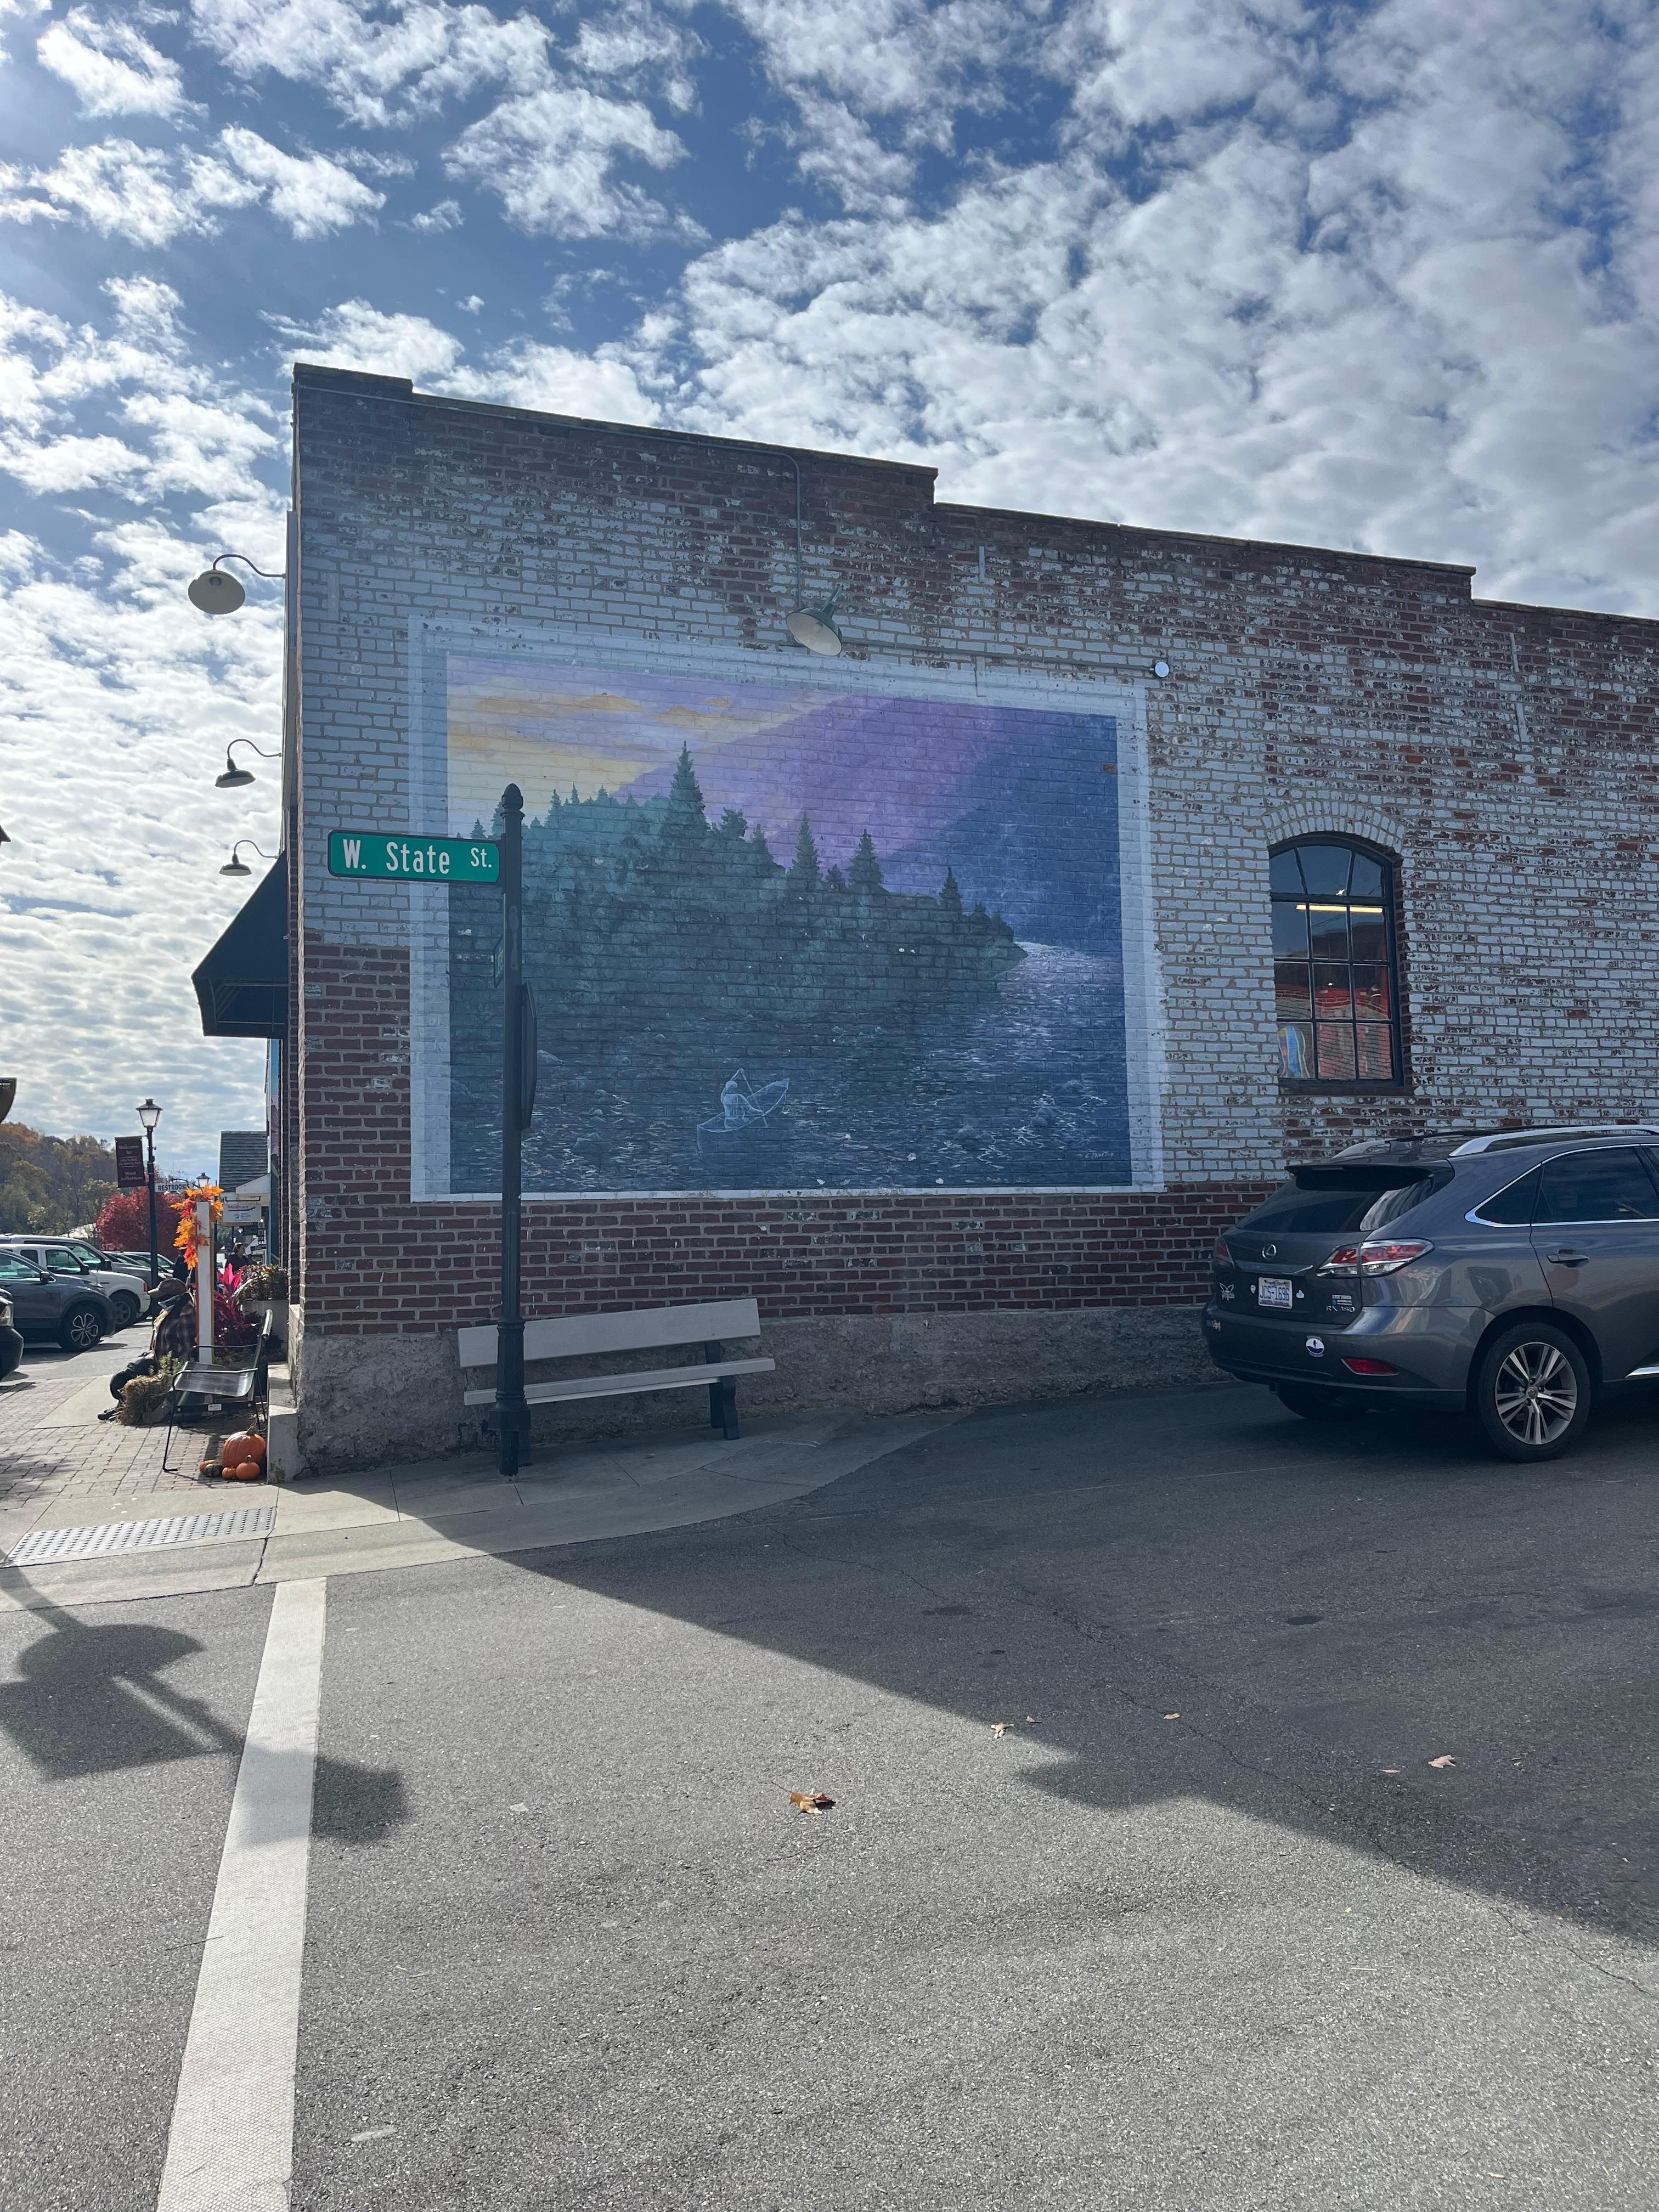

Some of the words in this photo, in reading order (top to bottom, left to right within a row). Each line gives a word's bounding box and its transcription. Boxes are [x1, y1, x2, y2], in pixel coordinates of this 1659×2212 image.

[343, 839, 366, 869] W.
[386, 842, 450, 874] State
[470, 847, 492, 868] St.
